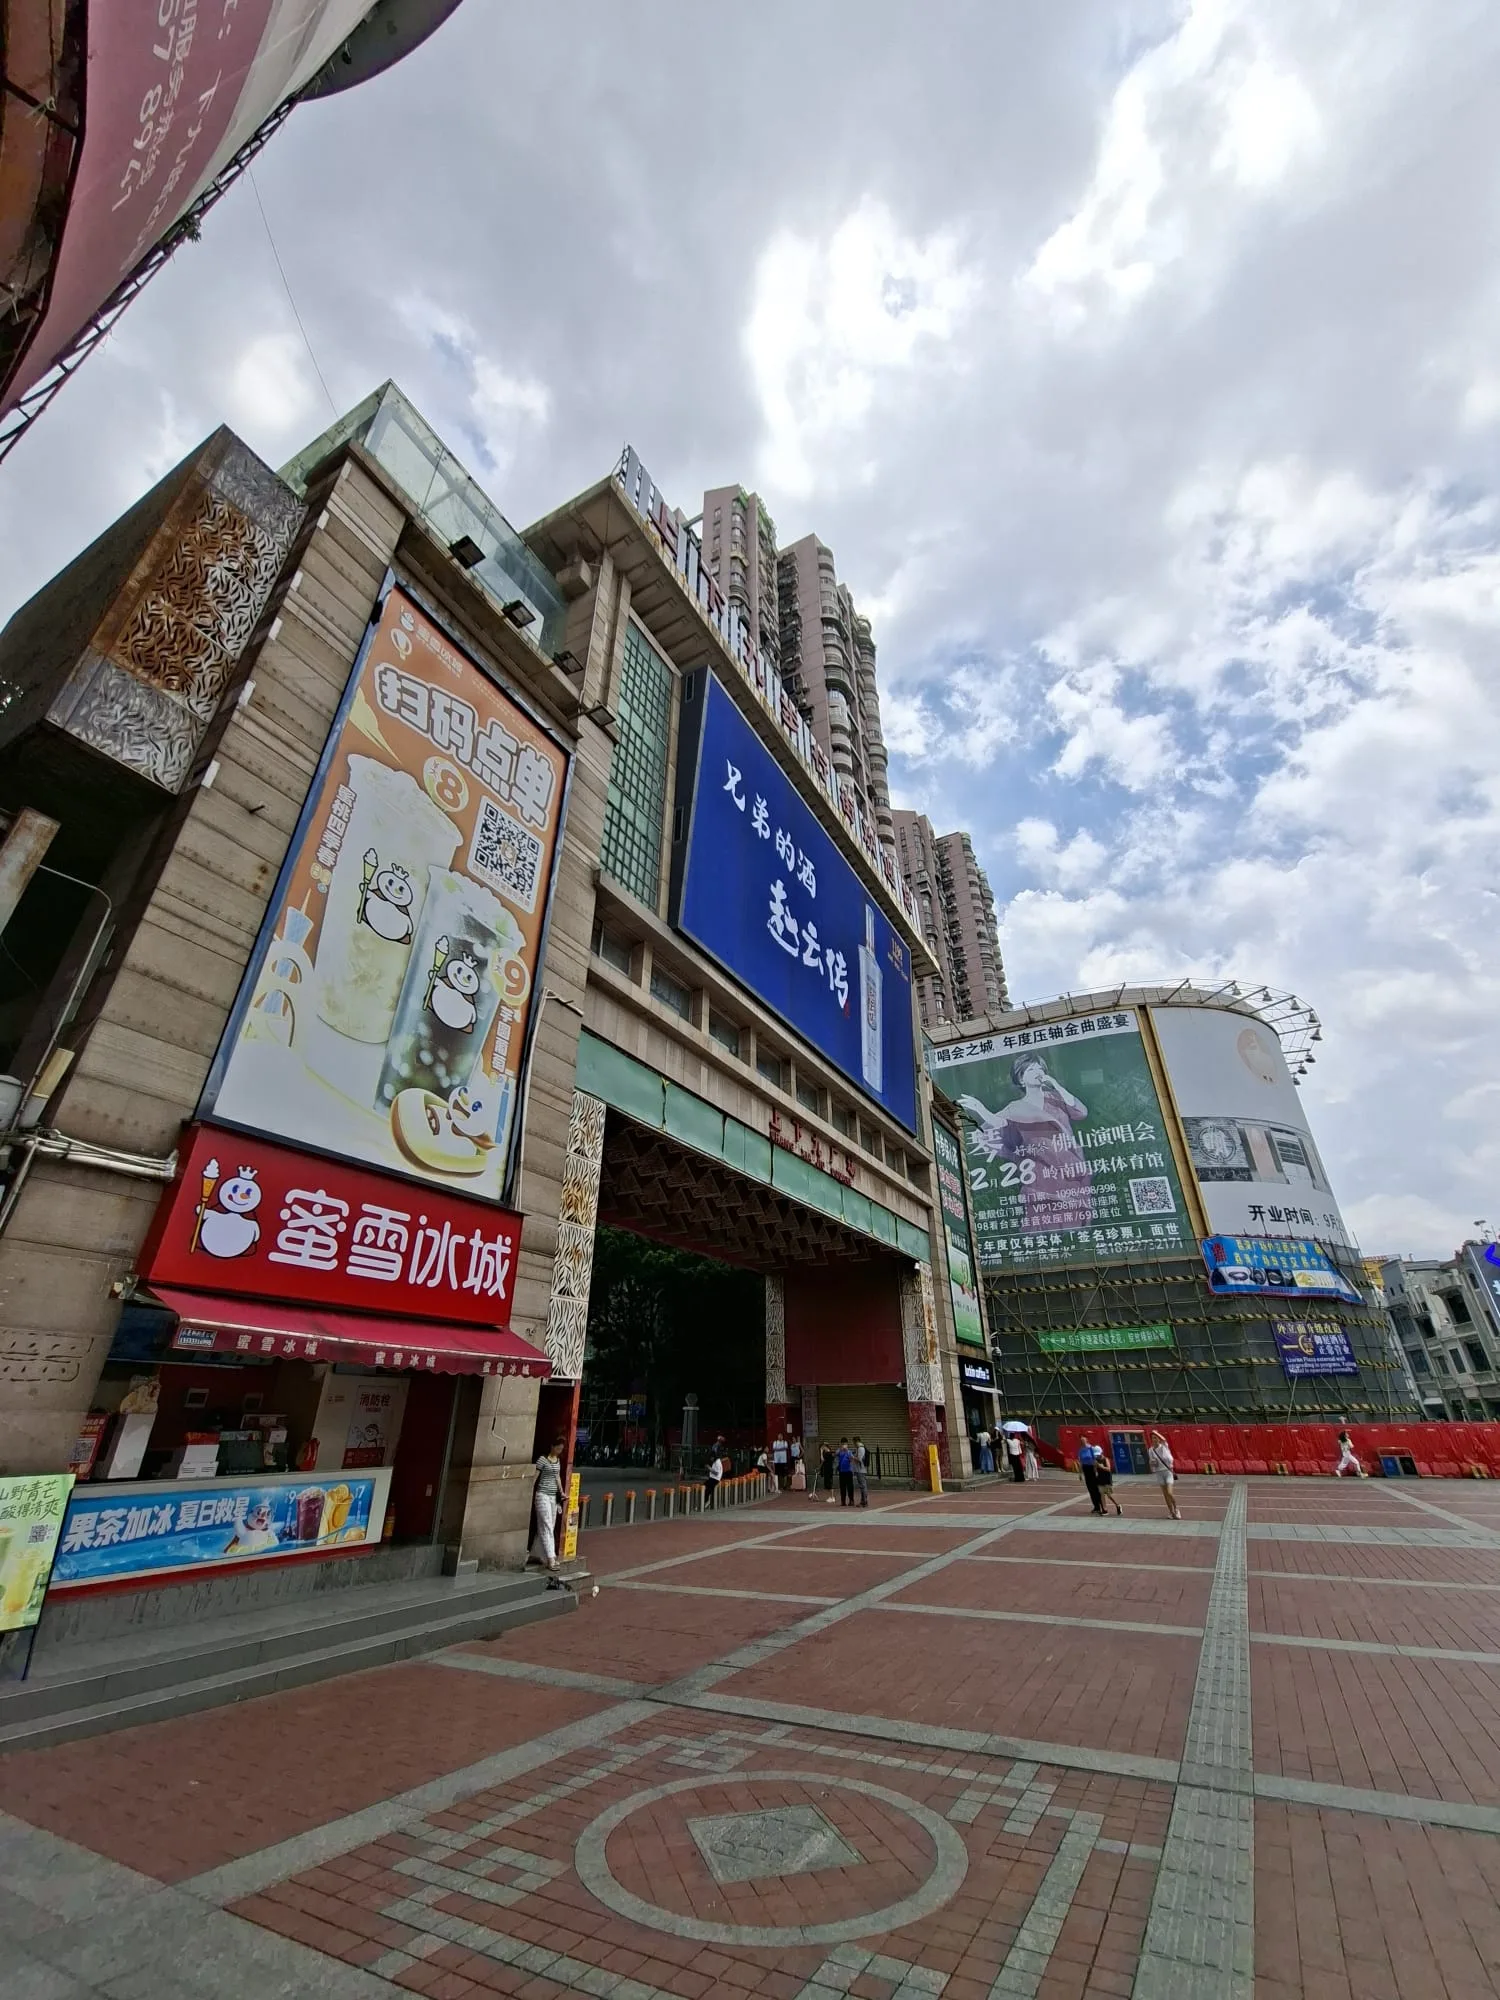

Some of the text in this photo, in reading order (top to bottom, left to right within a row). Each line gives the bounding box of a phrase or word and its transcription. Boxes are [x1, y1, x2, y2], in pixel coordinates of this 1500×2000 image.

[379, 666, 551, 830] 扫码点单
[722, 758, 817, 899] 兄弟的酒
[933, 1014, 1130, 1063] 唱会之城 年度压轴金曲盛宴
[1051, 1121, 1157, 1153] 佛山演唱会
[1042, 1151, 1165, 1180] 岭南明珠体育馆
[268, 1188, 512, 1300] 蜜雪冰城
[1149, 1222, 1180, 1236] 面世
[236, 1335, 318, 1355] 蜜雪冰城
[375, 1351, 436, 1368] 蜜雪冰城
[61, 1504, 176, 1552] 果茶加冰
[176, 1496, 250, 1530] 夏日救星
